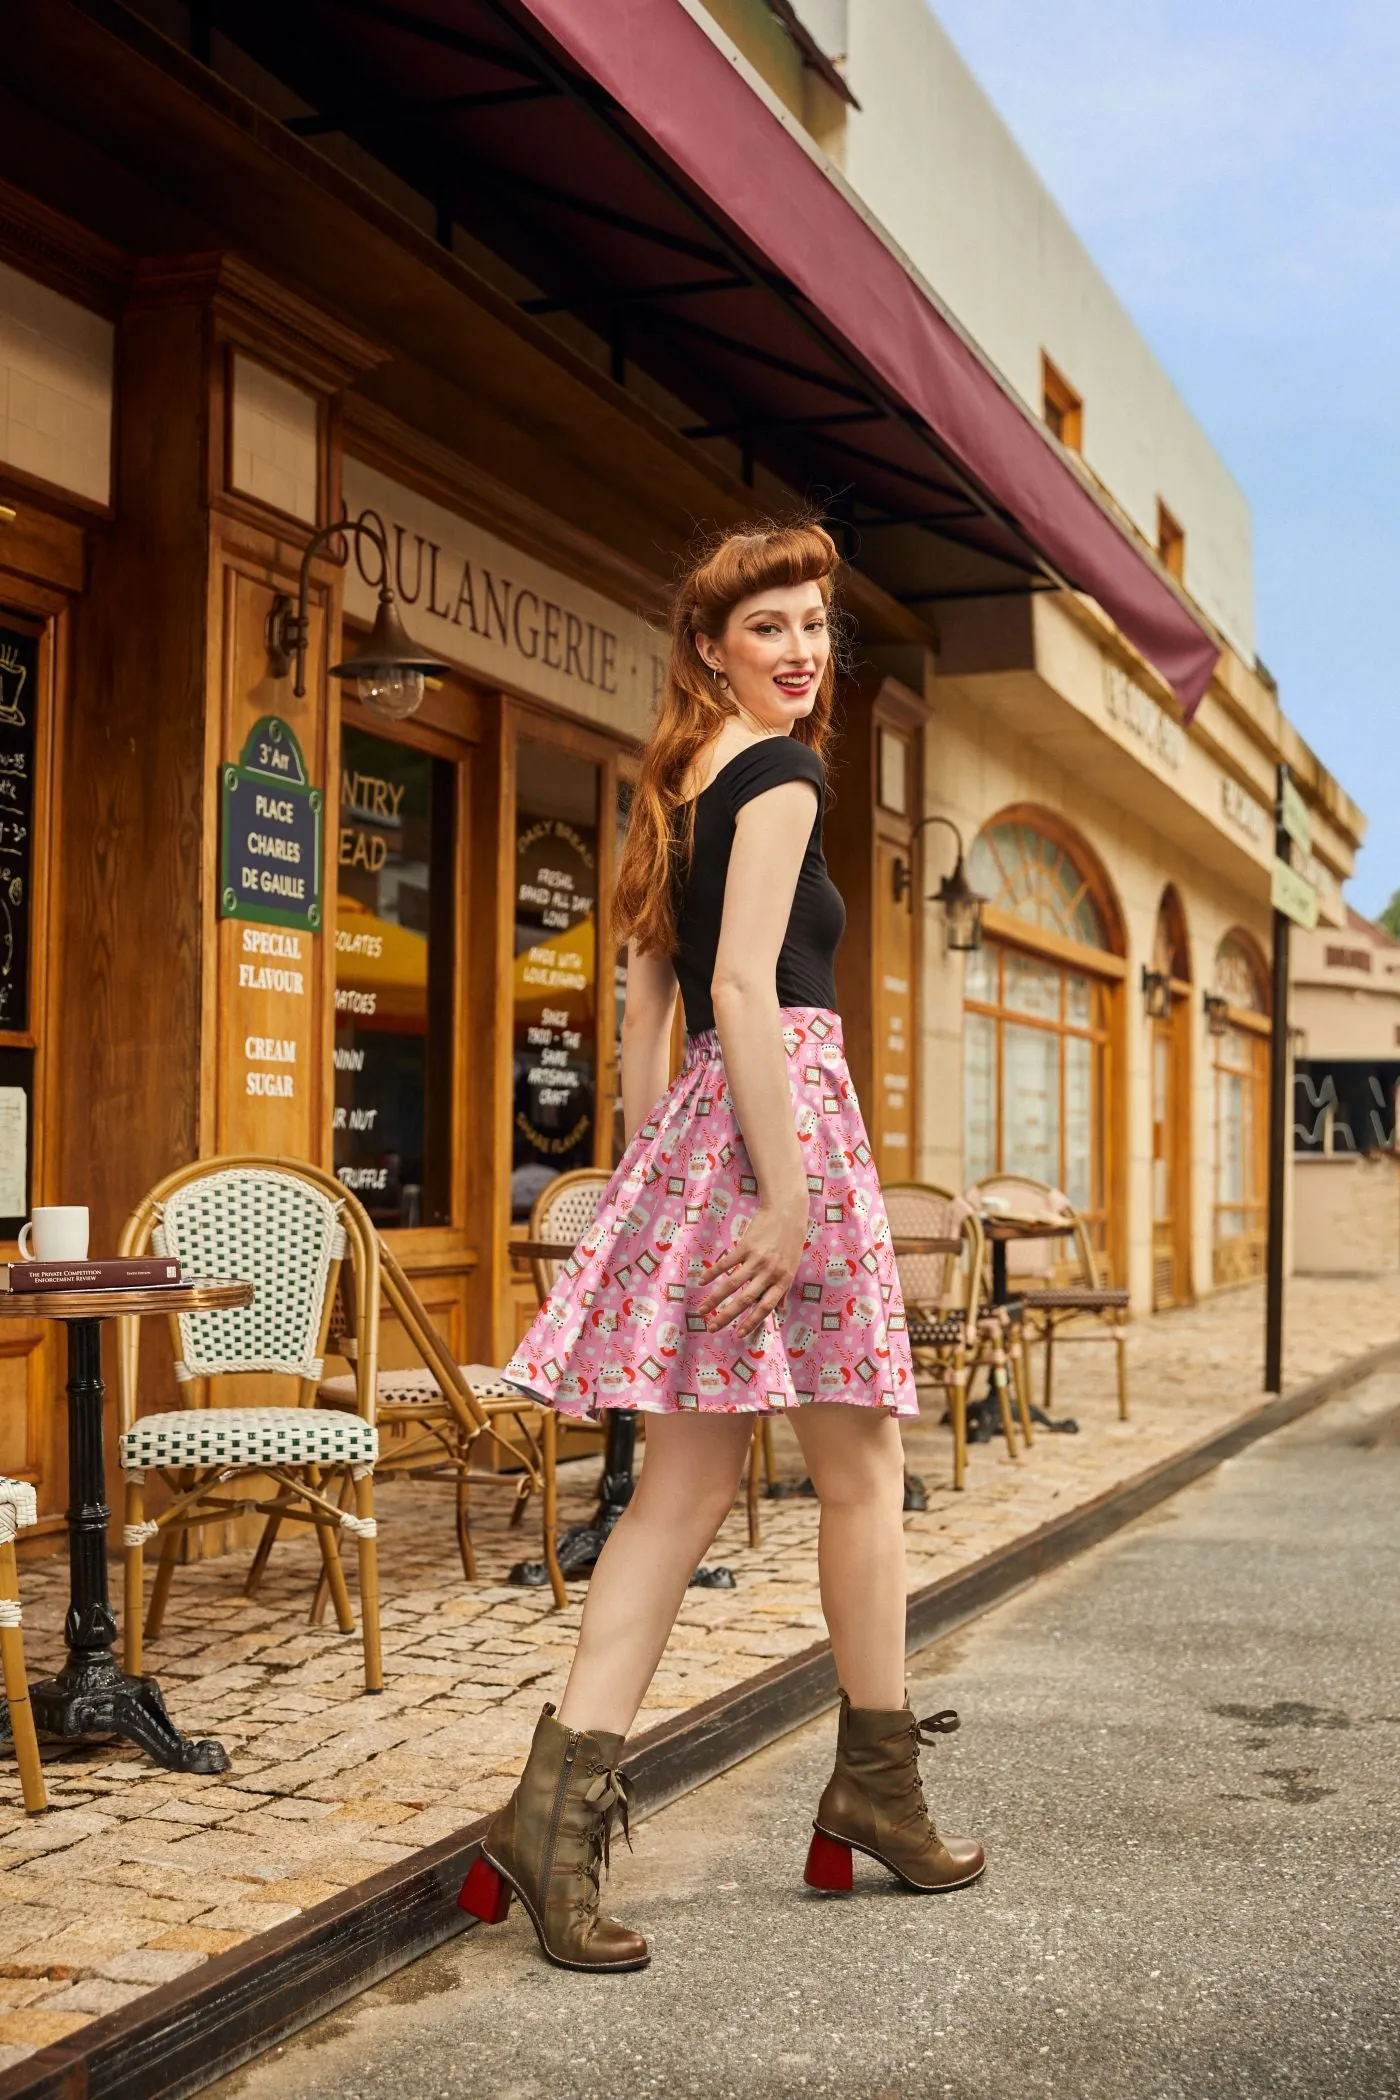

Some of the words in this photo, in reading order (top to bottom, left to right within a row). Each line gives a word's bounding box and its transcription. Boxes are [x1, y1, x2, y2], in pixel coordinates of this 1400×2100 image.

[336, 500, 618, 695] OULANGERIE
[255, 795, 294, 824] PLACE
[247, 832, 301, 864] CHARLES
[241, 866, 259, 890] DE
[260, 870, 305, 900] GAULLE
[551, 891, 570, 910] ALL
[571, 895, 594, 915] DAY
[542, 909, 570, 930] LONG
[242, 928, 302, 960] SPECIAL
[239, 963, 304, 995] FLAVOUR
[541, 1007, 569, 1028] SINCE
[245, 1036, 296, 1063] CREAM
[562, 1030, 582, 1049] THE
[540, 1047, 569, 1068] SAME
[246, 1072, 294, 1098] SUGAR
[527, 1067, 580, 1088] ARTISANAL
[538, 1088, 571, 1106] CRAFT
[349, 1108, 378, 1131] NUT
[337, 1166, 388, 1190] TRUFFLE
